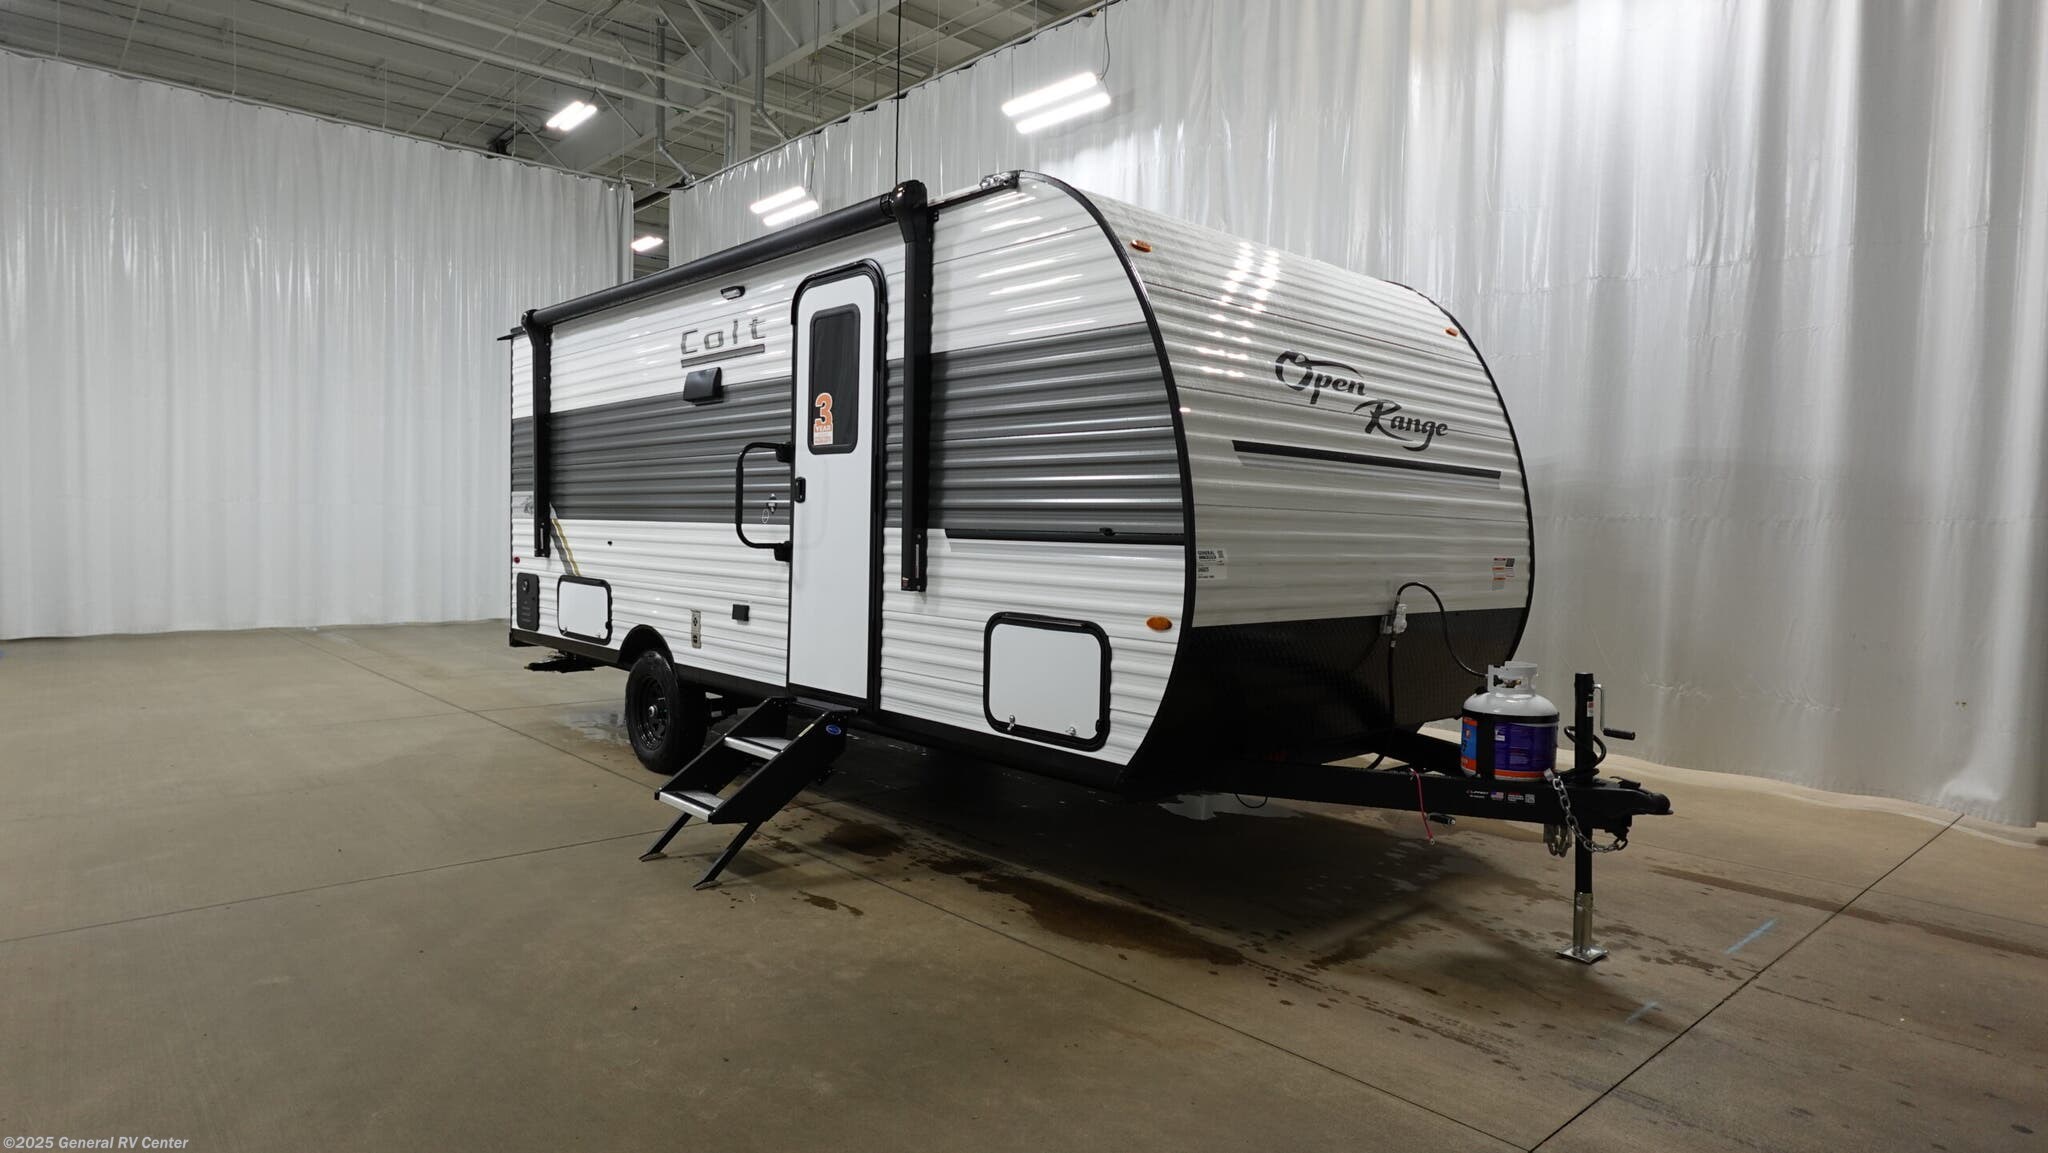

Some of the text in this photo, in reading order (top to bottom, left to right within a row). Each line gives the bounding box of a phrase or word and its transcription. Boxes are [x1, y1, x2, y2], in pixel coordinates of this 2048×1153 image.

[681, 317, 766, 354] Colt
[1275, 351, 1368, 405] Open
[815, 393, 833, 426] 3
[1353, 399, 1449, 452] Range
